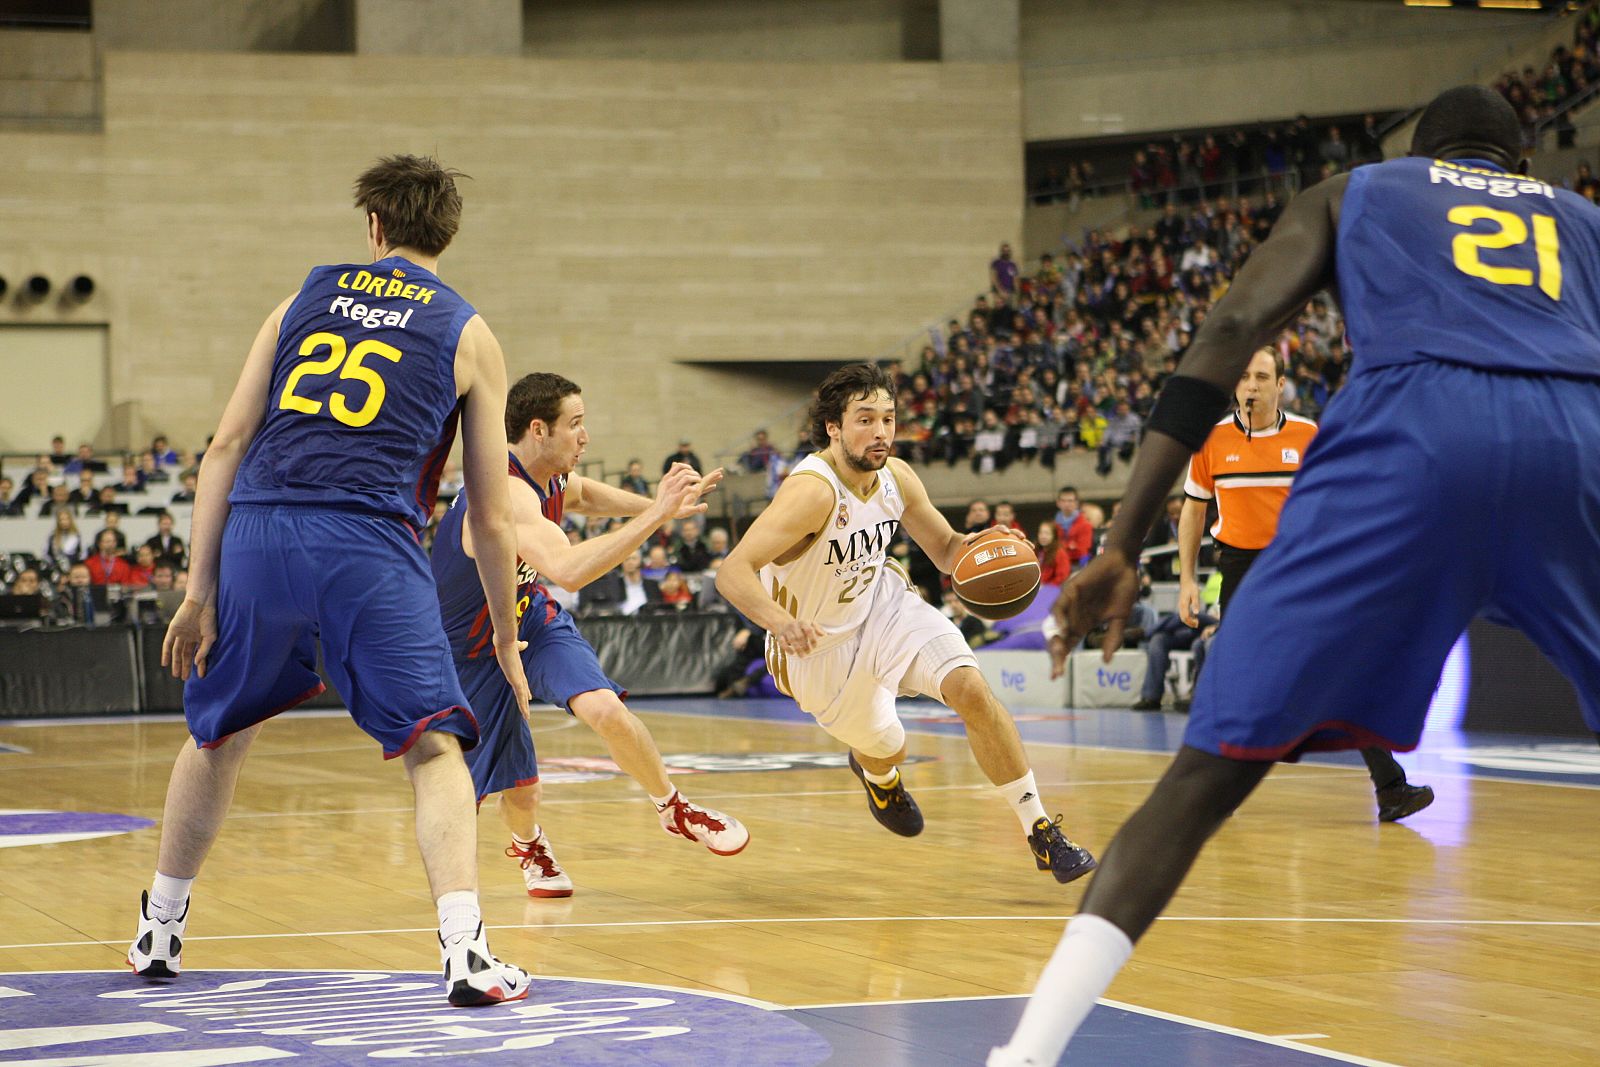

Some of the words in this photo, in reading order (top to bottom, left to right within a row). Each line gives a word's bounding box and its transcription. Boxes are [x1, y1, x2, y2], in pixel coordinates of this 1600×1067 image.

[1429, 166, 1555, 199] Regal
[1447, 205, 1563, 301] 21
[337, 270, 437, 305] LORBEK
[329, 295, 414, 329] Regal
[279, 331, 403, 428] 25
[824, 519, 900, 565] MMT
[1001, 668, 1026, 692] tve
[1096, 667, 1131, 692] tve
